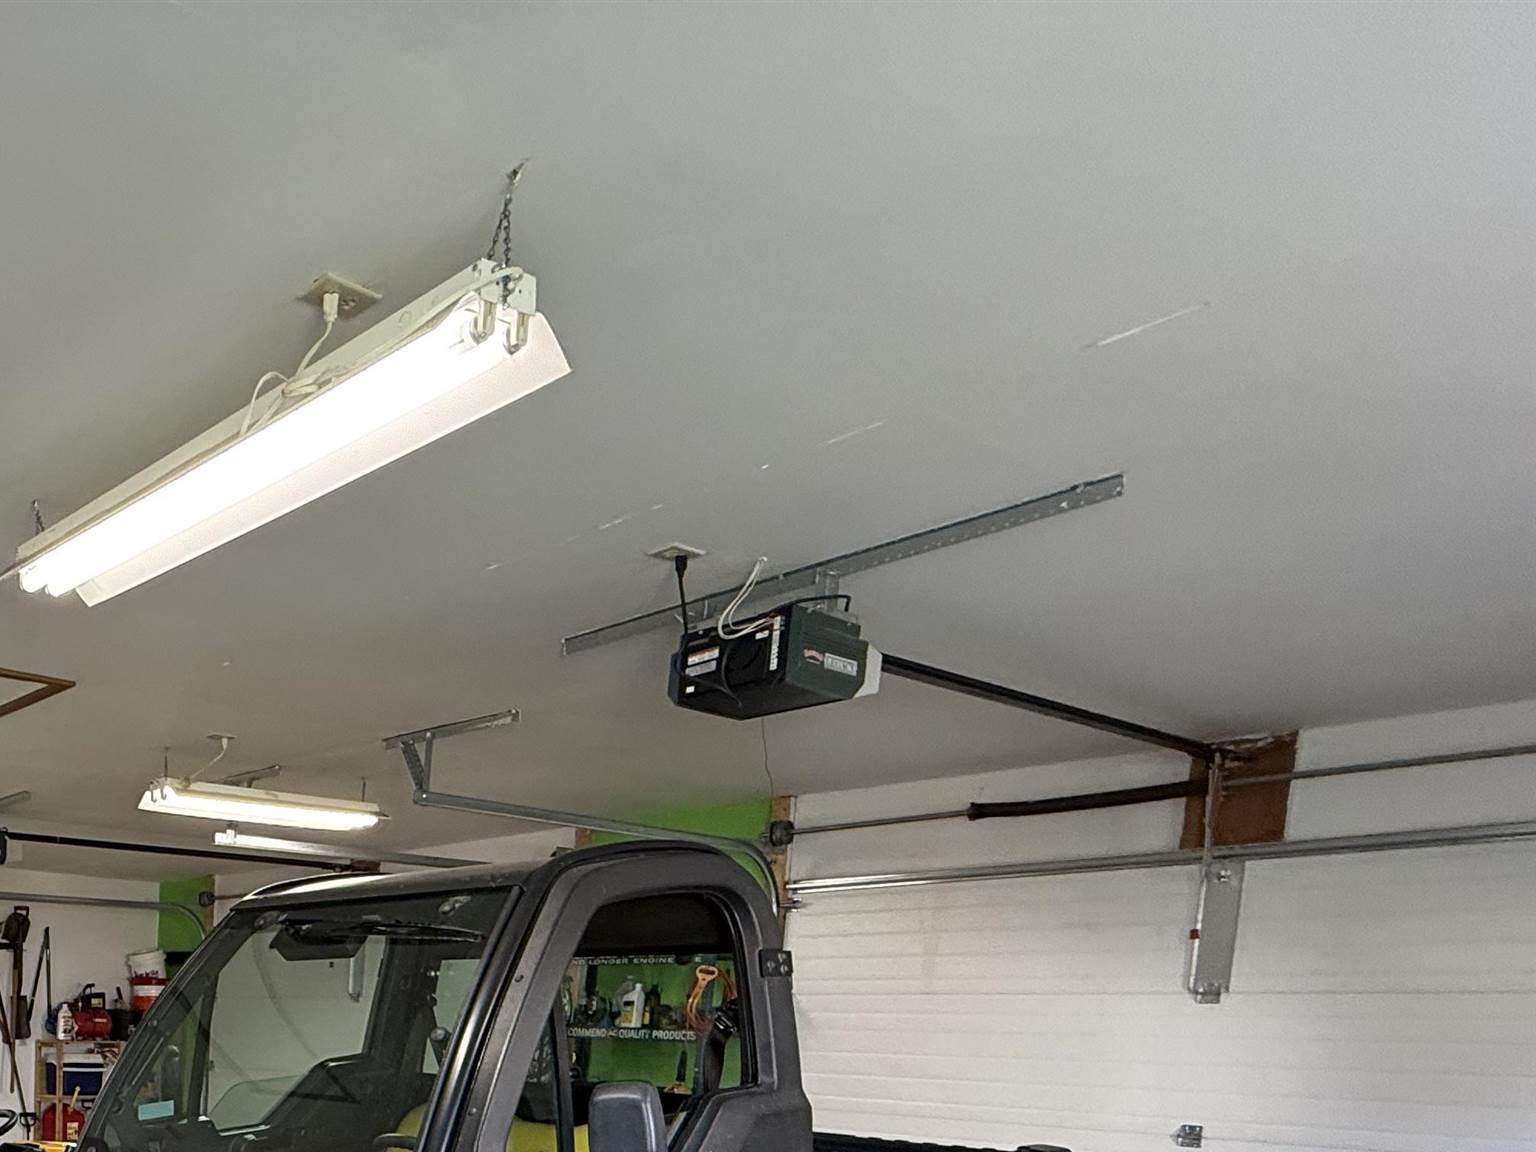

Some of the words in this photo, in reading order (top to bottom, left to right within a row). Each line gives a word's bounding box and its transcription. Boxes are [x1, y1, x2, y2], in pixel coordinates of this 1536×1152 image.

[633, 957, 675, 965] ENGINE
[567, 1027, 607, 1038] COMMEND
[618, 1028, 651, 1040] QUALITY
[651, 1029, 697, 1041] PRODUCTS
